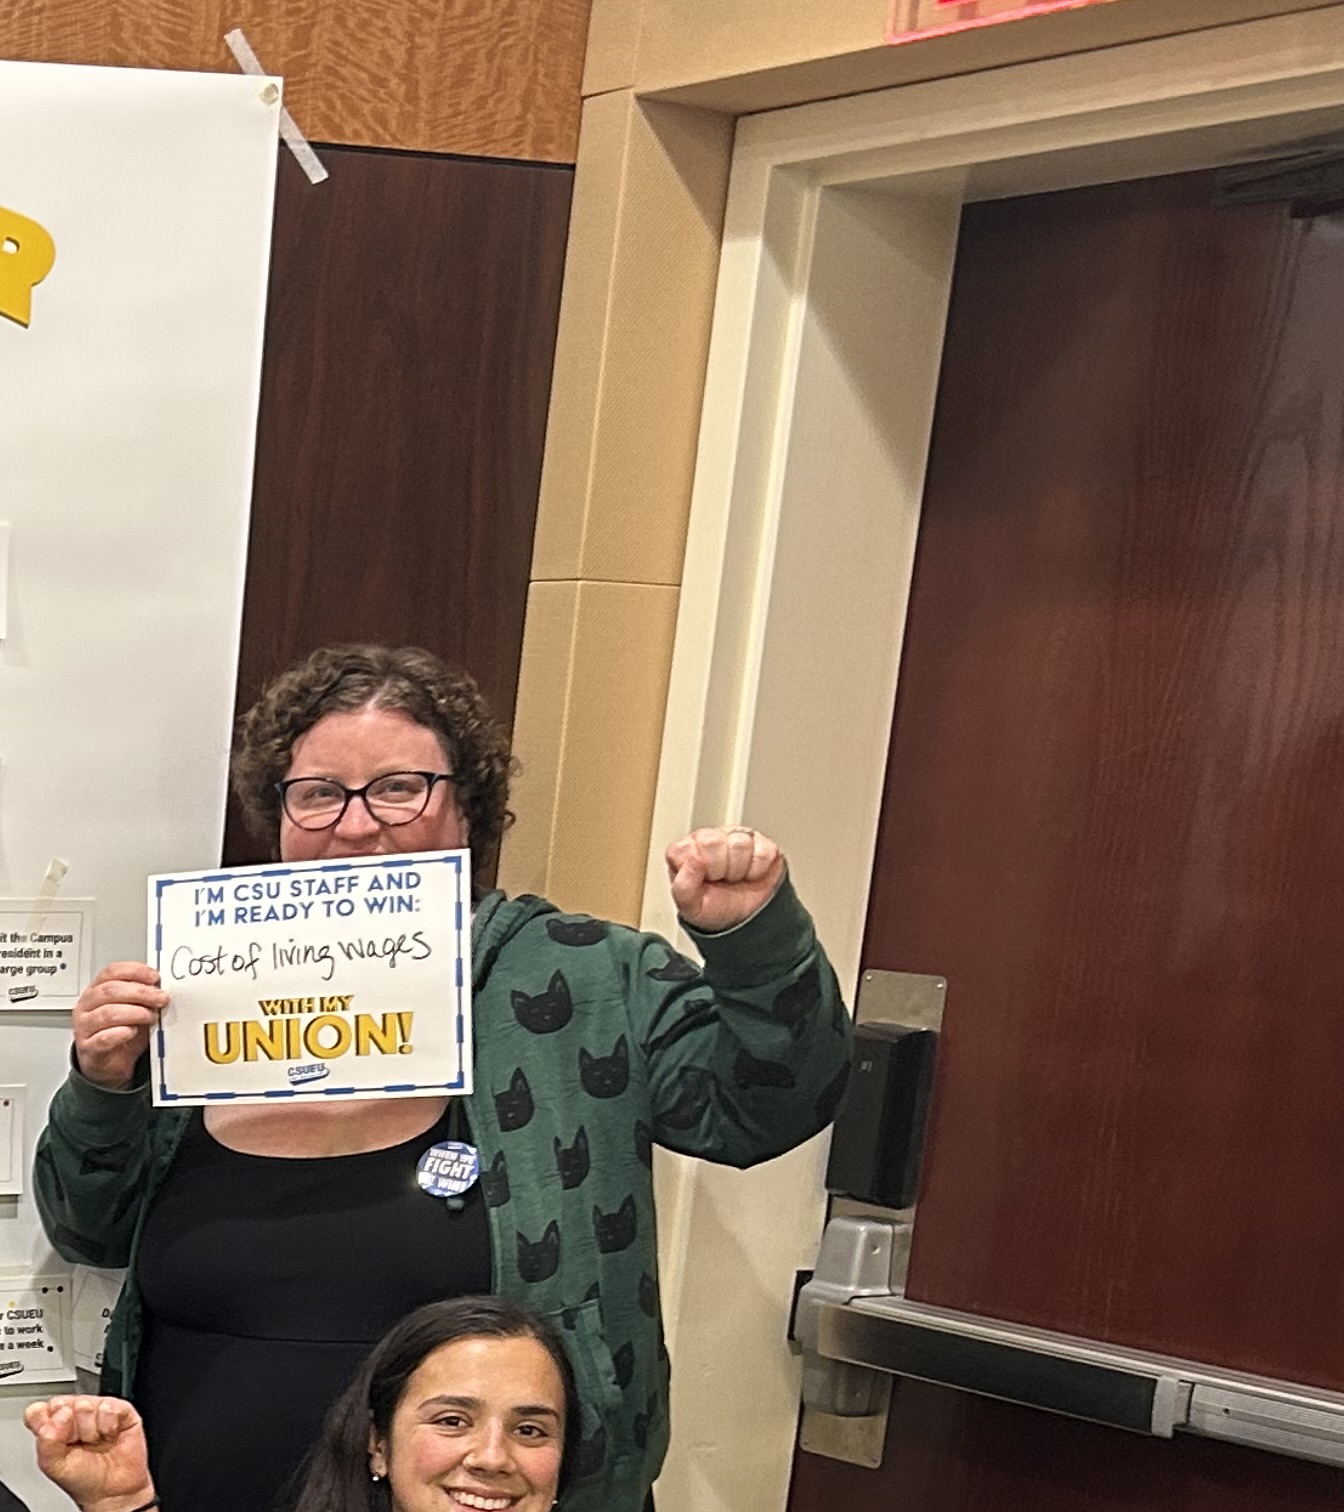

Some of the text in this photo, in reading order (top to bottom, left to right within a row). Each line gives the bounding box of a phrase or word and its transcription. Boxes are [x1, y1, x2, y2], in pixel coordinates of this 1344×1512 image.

[194, 871, 421, 905] I'M CSU STAFF AND
[194, 894, 421, 927] I'M READY TO WIN:
[10, 932, 27, 943] the
[30, 933, 73, 945] Campus
[43, 948, 53, 958] in
[171, 944, 224, 980] Cost
[232, 942, 262, 980] of
[272, 939, 335, 980] living
[26, 964, 57, 976] group
[203, 1011, 414, 1065] UNION!
[424, 1156, 475, 1180] FIGHT
[4, 1327, 15, 1336] to
[17, 1324, 43, 1335] work
[16, 1339, 44, 1349] week
